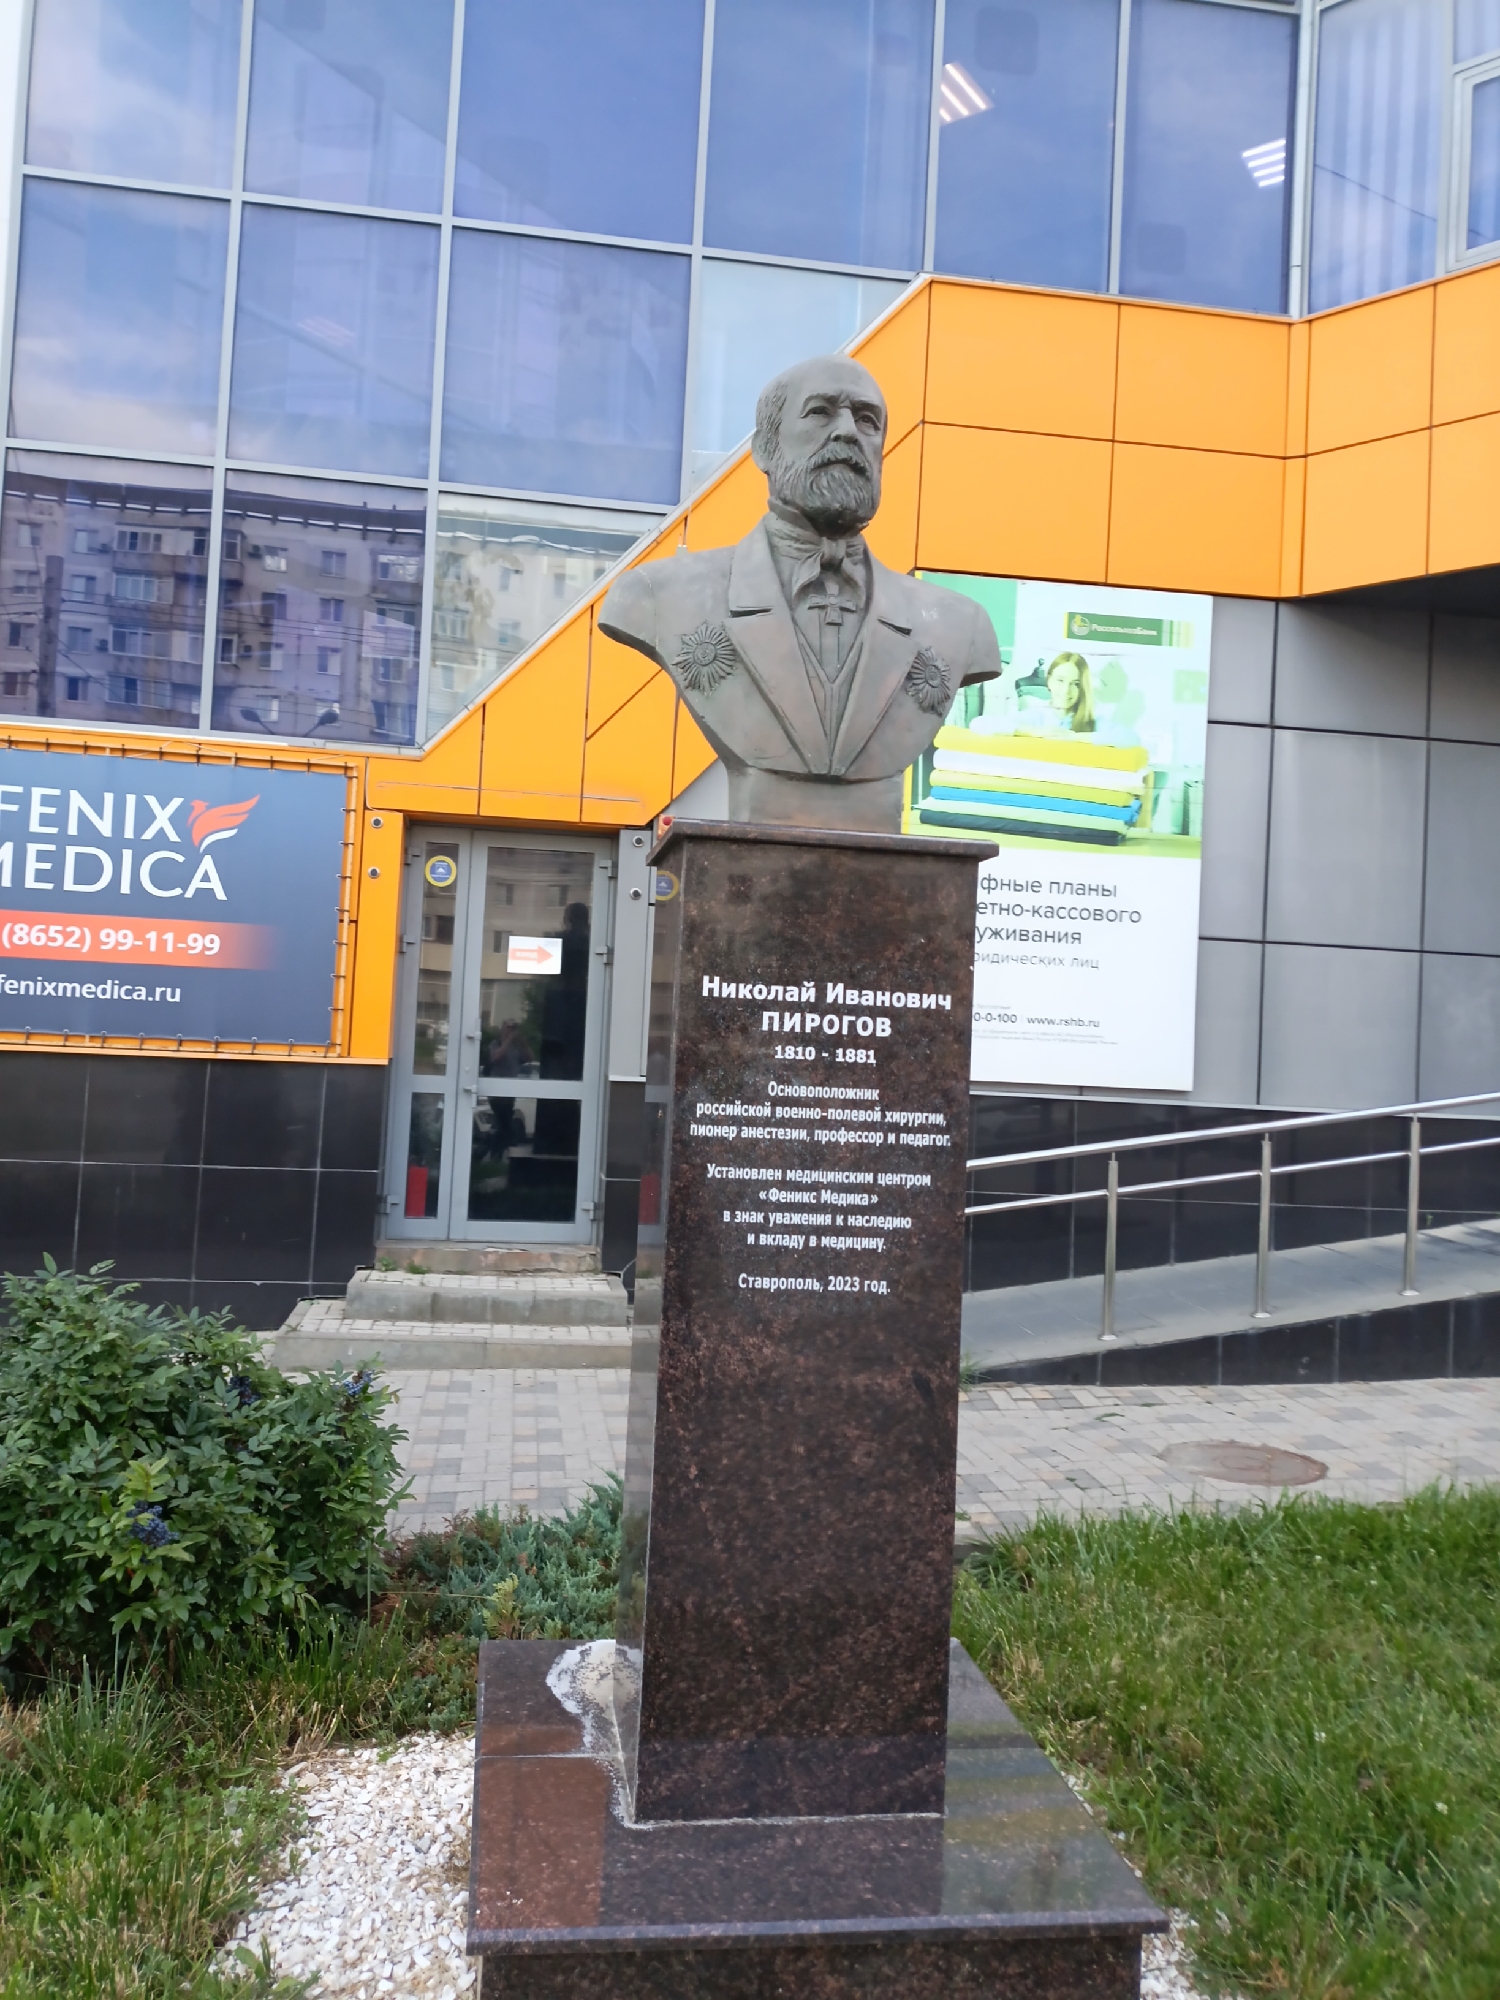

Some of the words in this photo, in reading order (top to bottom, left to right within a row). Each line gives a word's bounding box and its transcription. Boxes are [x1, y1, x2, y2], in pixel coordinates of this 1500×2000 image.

[0, 784, 185, 843] FENIX
[1049, 881, 1117, 898] планы
[2, 922, 91, 952] (8652)
[100, 928, 221, 955] 99-11-99
[1070, 957, 1100, 970] лиц
[0, 974, 181, 1002] fenixmedica.ru
[702, 975, 817, 1003] Николай
[826, 982, 952, 1010] Иванович
[761, 1011, 892, 1038] ПИРОГОВ
[1027, 1016, 1100, 1029] www.rshb.ru
[774, 1045, 816, 1061] 1810
[835, 1048, 877, 1064] 1881
[768, 1081, 880, 1101] Основоположник
[697, 1100, 771, 1118] российской
[775, 1106, 882, 1122] военно-полевой
[885, 1112, 947, 1127] хирургии,
[690, 1122, 737, 1141] пионер
[741, 1126, 811, 1142] анестезии,
[814, 1128, 884, 1146] профессор
[888, 1132, 895, 1144] и
[900, 1132, 951, 1148] педагог.
[707, 1163, 782, 1181] Установлен
[786, 1168, 873, 1184] медицинским
[877, 1170, 931, 1188] центром
[759, 1187, 817, 1204] «Феникс
[821, 1189, 879, 1206] Медика»
[723, 1210, 730, 1222] в
[734, 1211, 764, 1223] знак
[768, 1211, 831, 1227] уважения
[836, 1214, 844, 1226] к
[848, 1214, 912, 1229] наследию
[747, 1233, 755, 1245] и
[759, 1233, 805, 1250] вкладу
[809, 1235, 816, 1247] в
[821, 1235, 887, 1252] медицину.
[738, 1272, 824, 1292] Ставрополь,
[828, 1276, 860, 1292] 2023
[864, 1280, 891, 1295] год.
